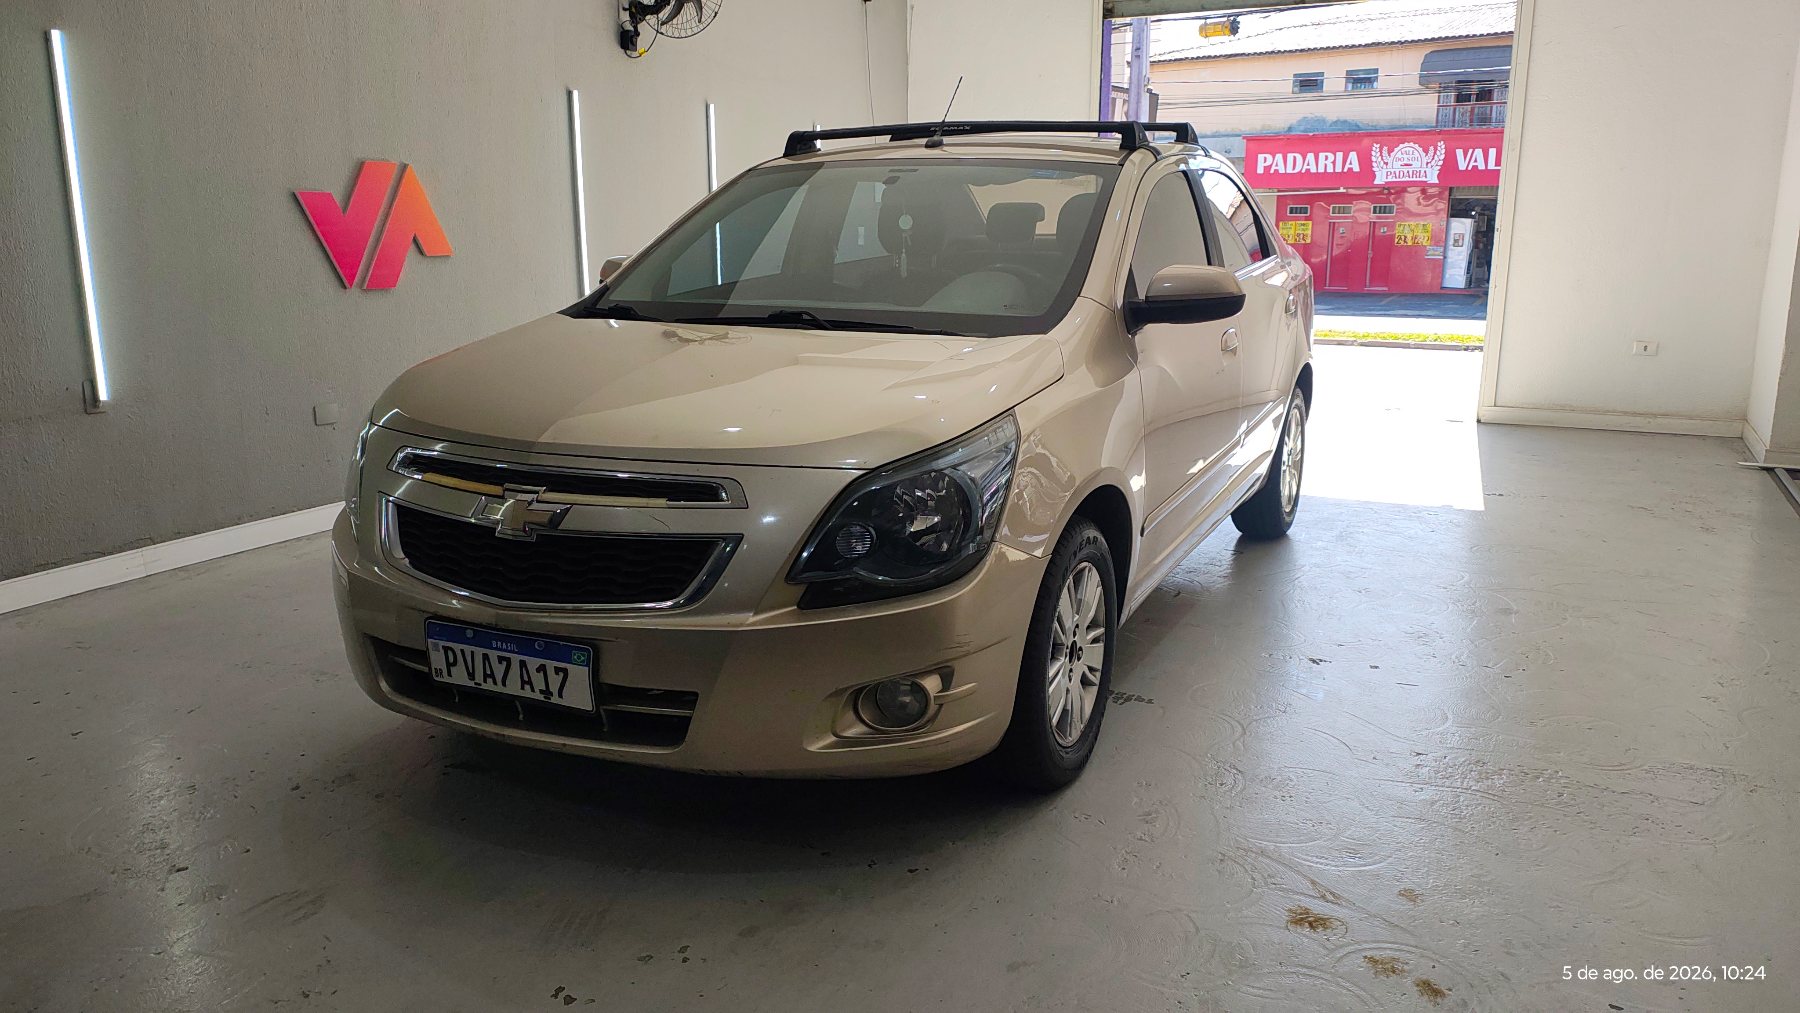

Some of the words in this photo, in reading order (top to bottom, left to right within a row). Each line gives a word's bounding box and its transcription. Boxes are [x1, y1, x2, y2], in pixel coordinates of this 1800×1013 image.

[1256, 151, 1361, 174] PADARIA
[1385, 169, 1428, 180] PADARIA
[491, 640, 518, 652] BRASIL
[433, 667, 445, 679] BR
[441, 645, 570, 700] PVA7A17
